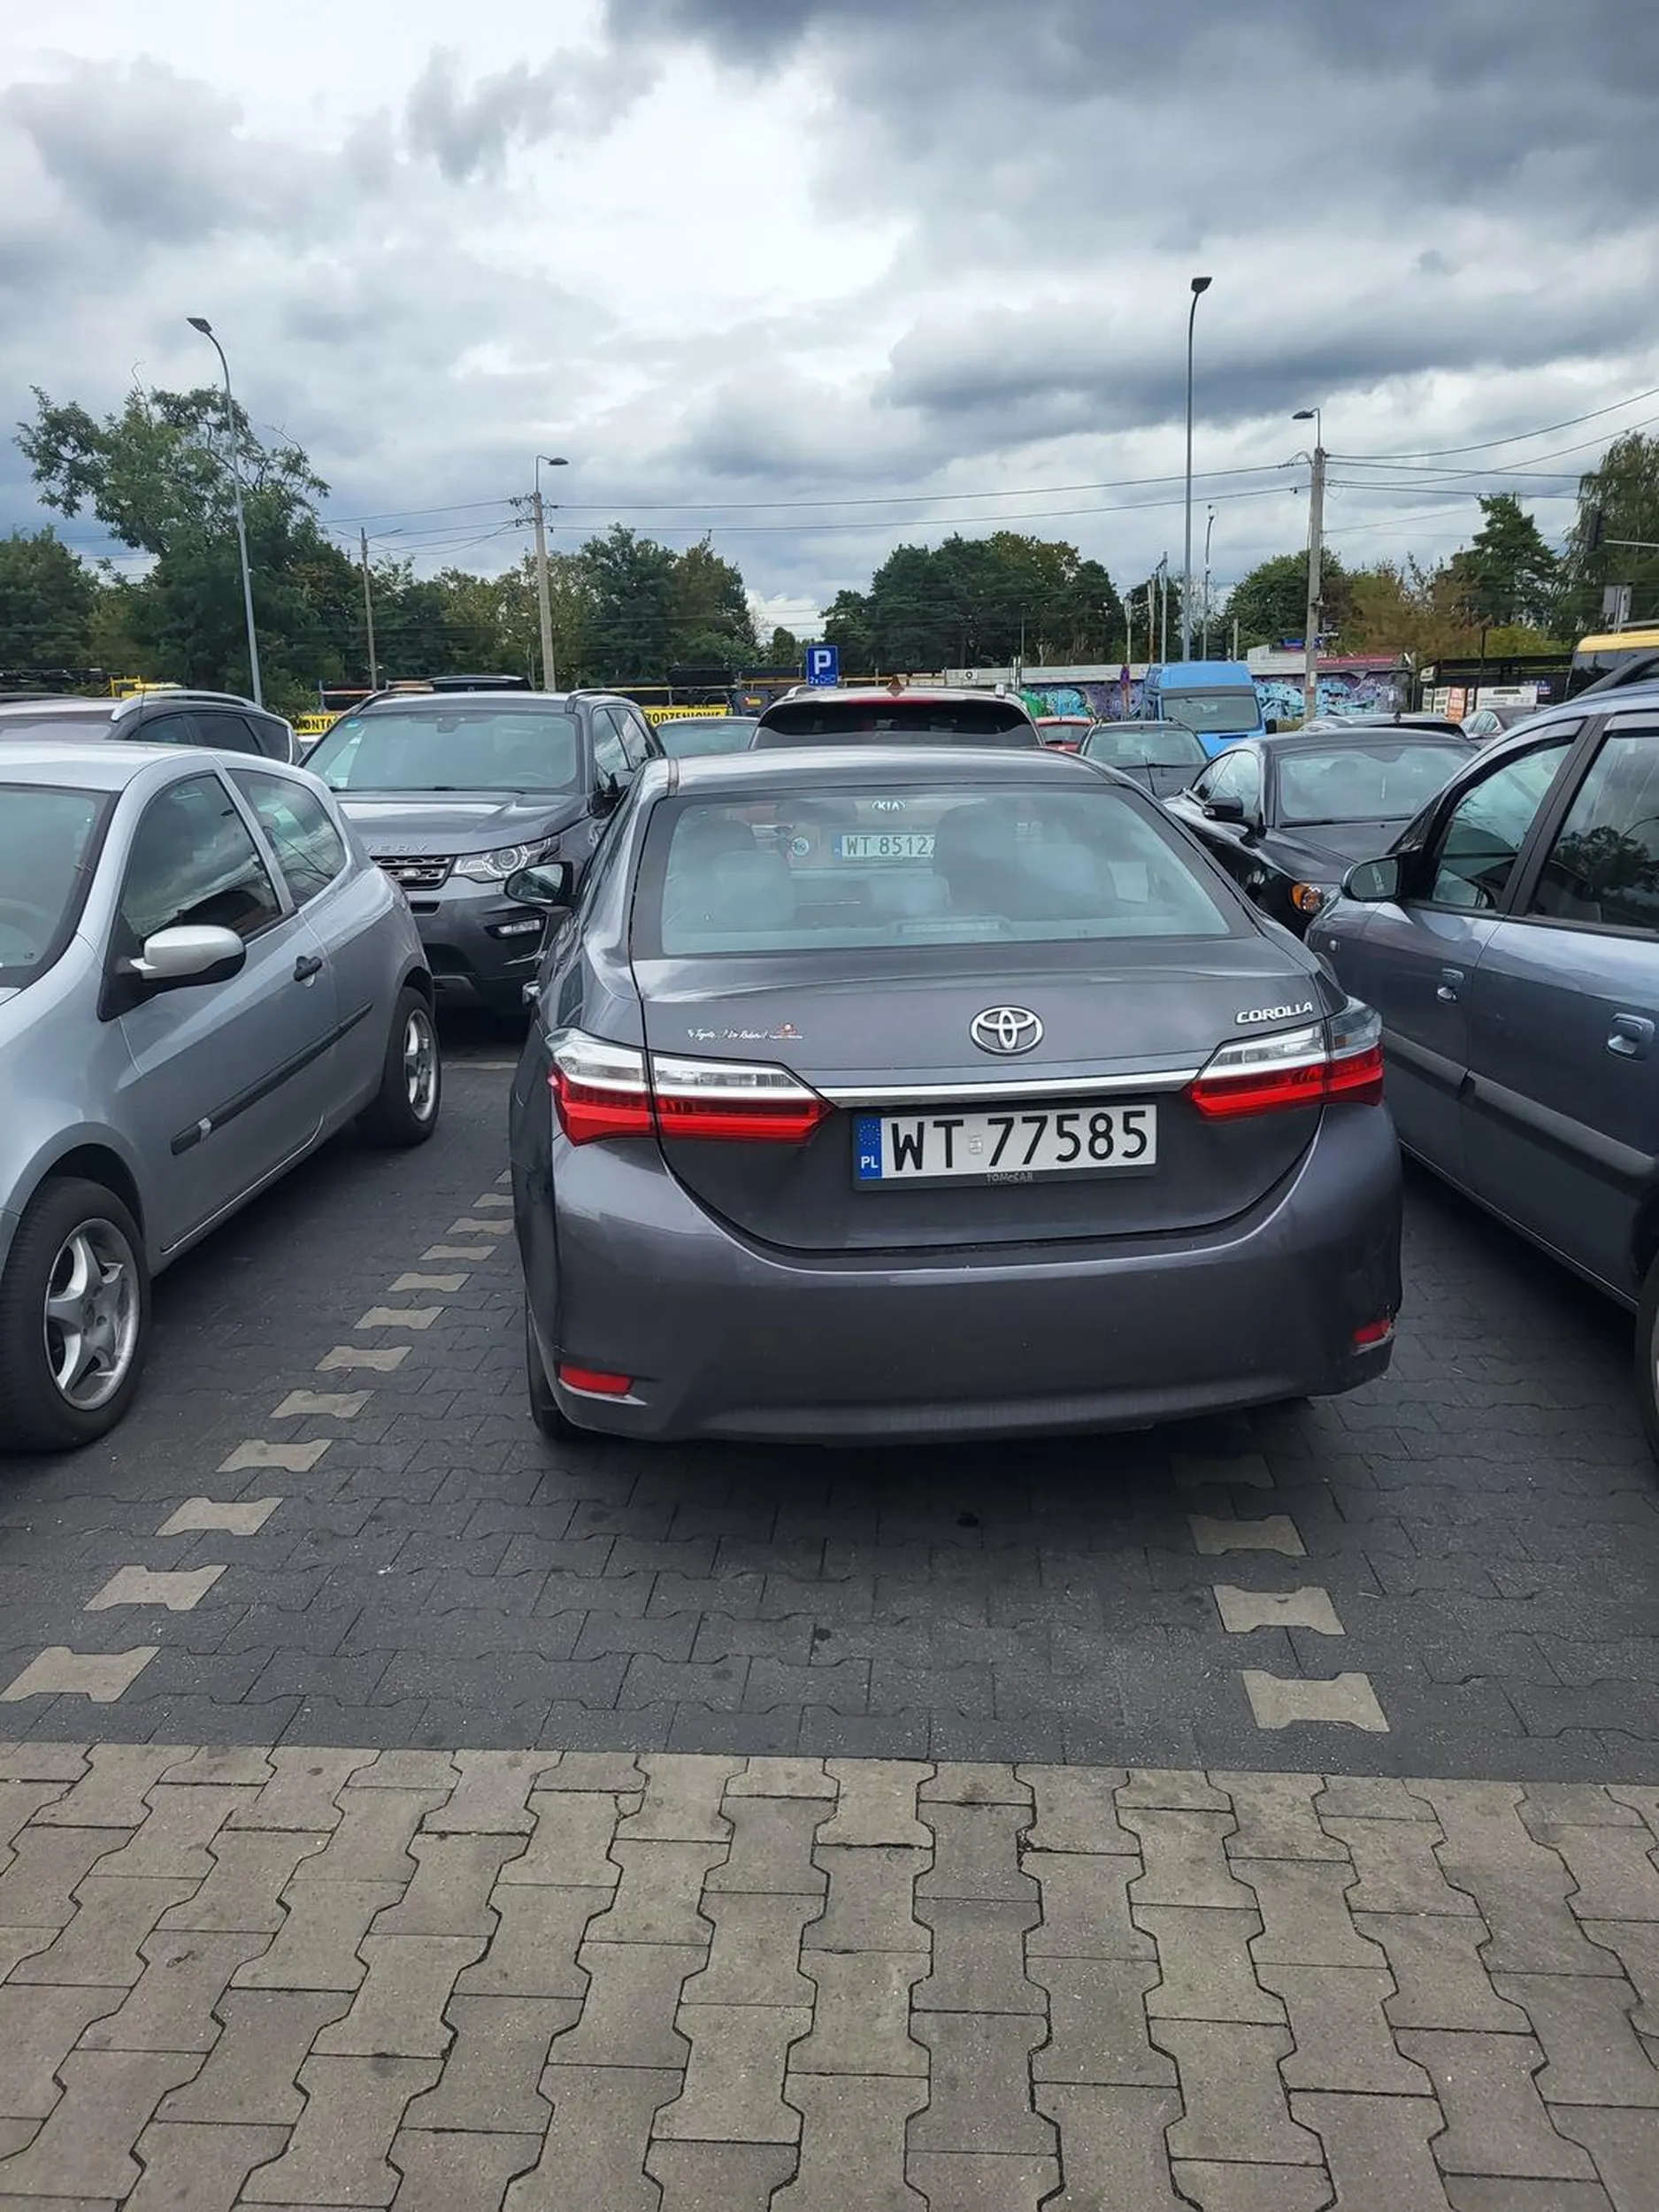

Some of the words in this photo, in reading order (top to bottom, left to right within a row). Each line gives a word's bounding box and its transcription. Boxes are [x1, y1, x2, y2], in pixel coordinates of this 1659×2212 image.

[813, 649, 832, 674] P
[292, 718, 334, 731] MONTA
[873, 800, 904, 811] KIA
[846, 836, 872, 855] WT
[879, 836, 934, 856] 8512
[1236, 1002, 1313, 1024] COROLLA
[891, 1119, 964, 1171] WT
[987, 1110, 1148, 1167] 77585
[860, 1156, 879, 1169] PL
